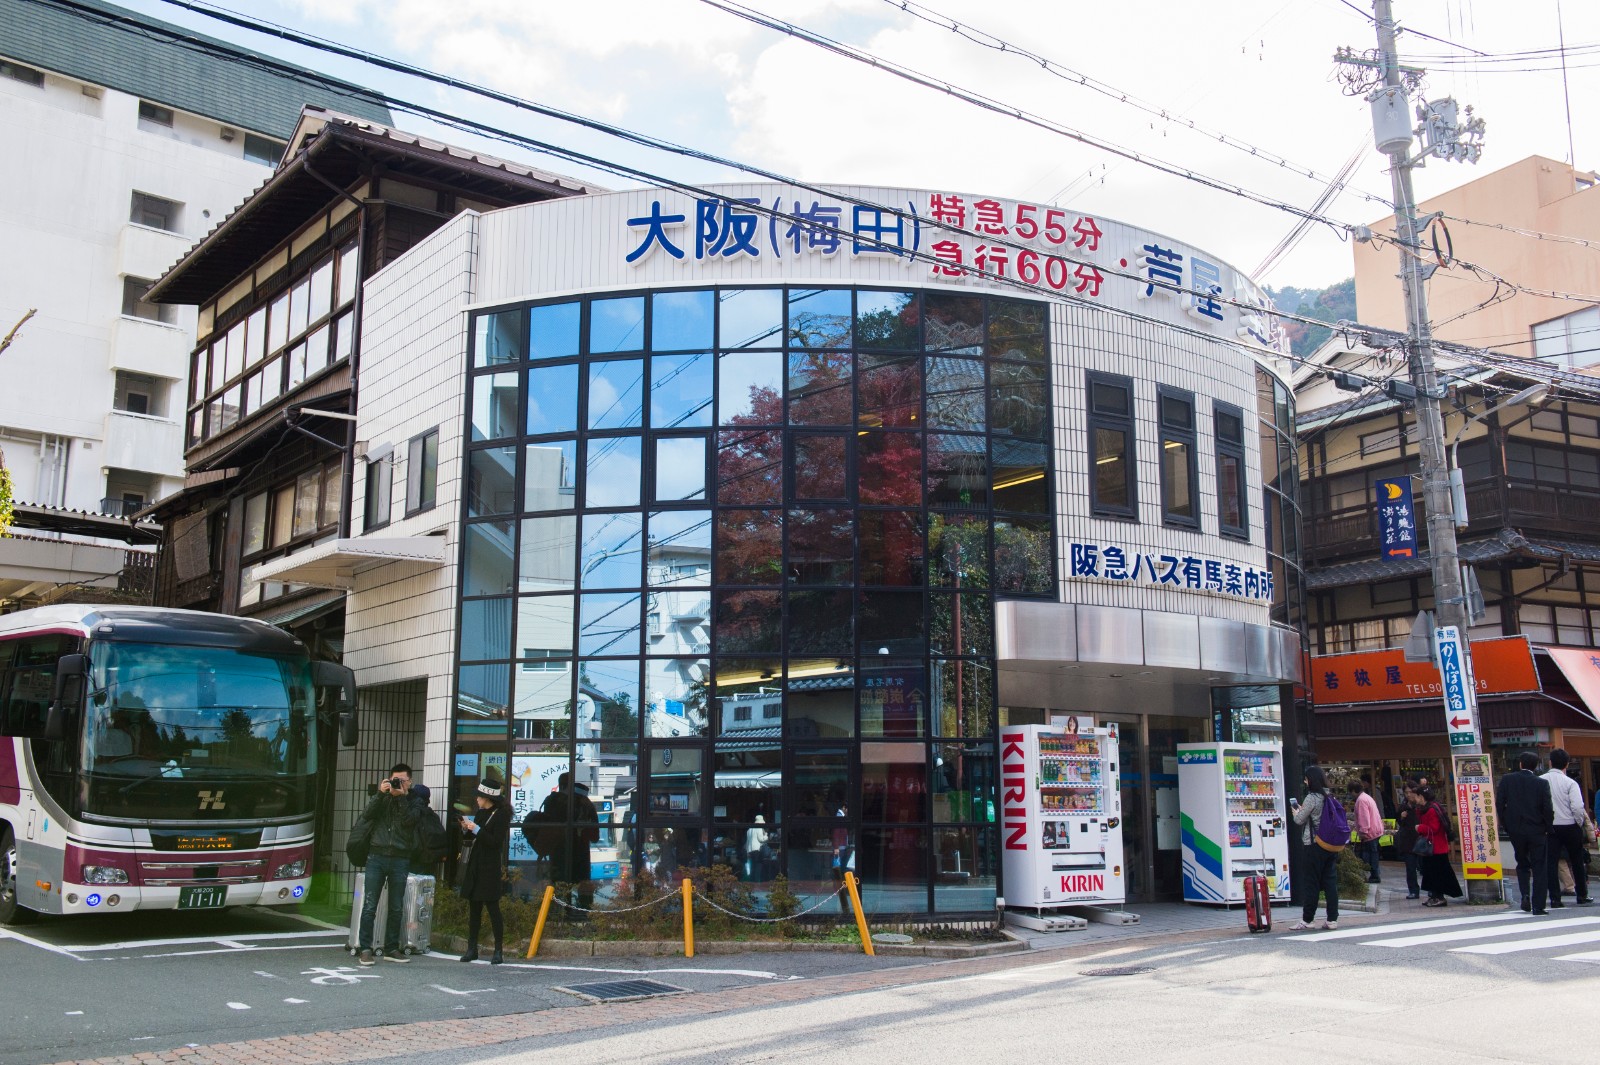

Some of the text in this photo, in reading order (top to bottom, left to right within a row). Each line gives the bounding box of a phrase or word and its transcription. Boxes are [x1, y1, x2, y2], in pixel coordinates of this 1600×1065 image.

[625, 196, 920, 263] 大阪(梅田)
[930, 193, 1103, 251] 特急55分
[931, 239, 1104, 297] 急行60分
[1071, 543, 1274, 601] 阪急バス有馬案内所
[1437, 629, 1456, 639] 有馬
[1440, 643, 1463, 710] かんぽの宿
[1002, 733, 1028, 851] KIRIN
[1060, 874, 1104, 893] KIRIN
